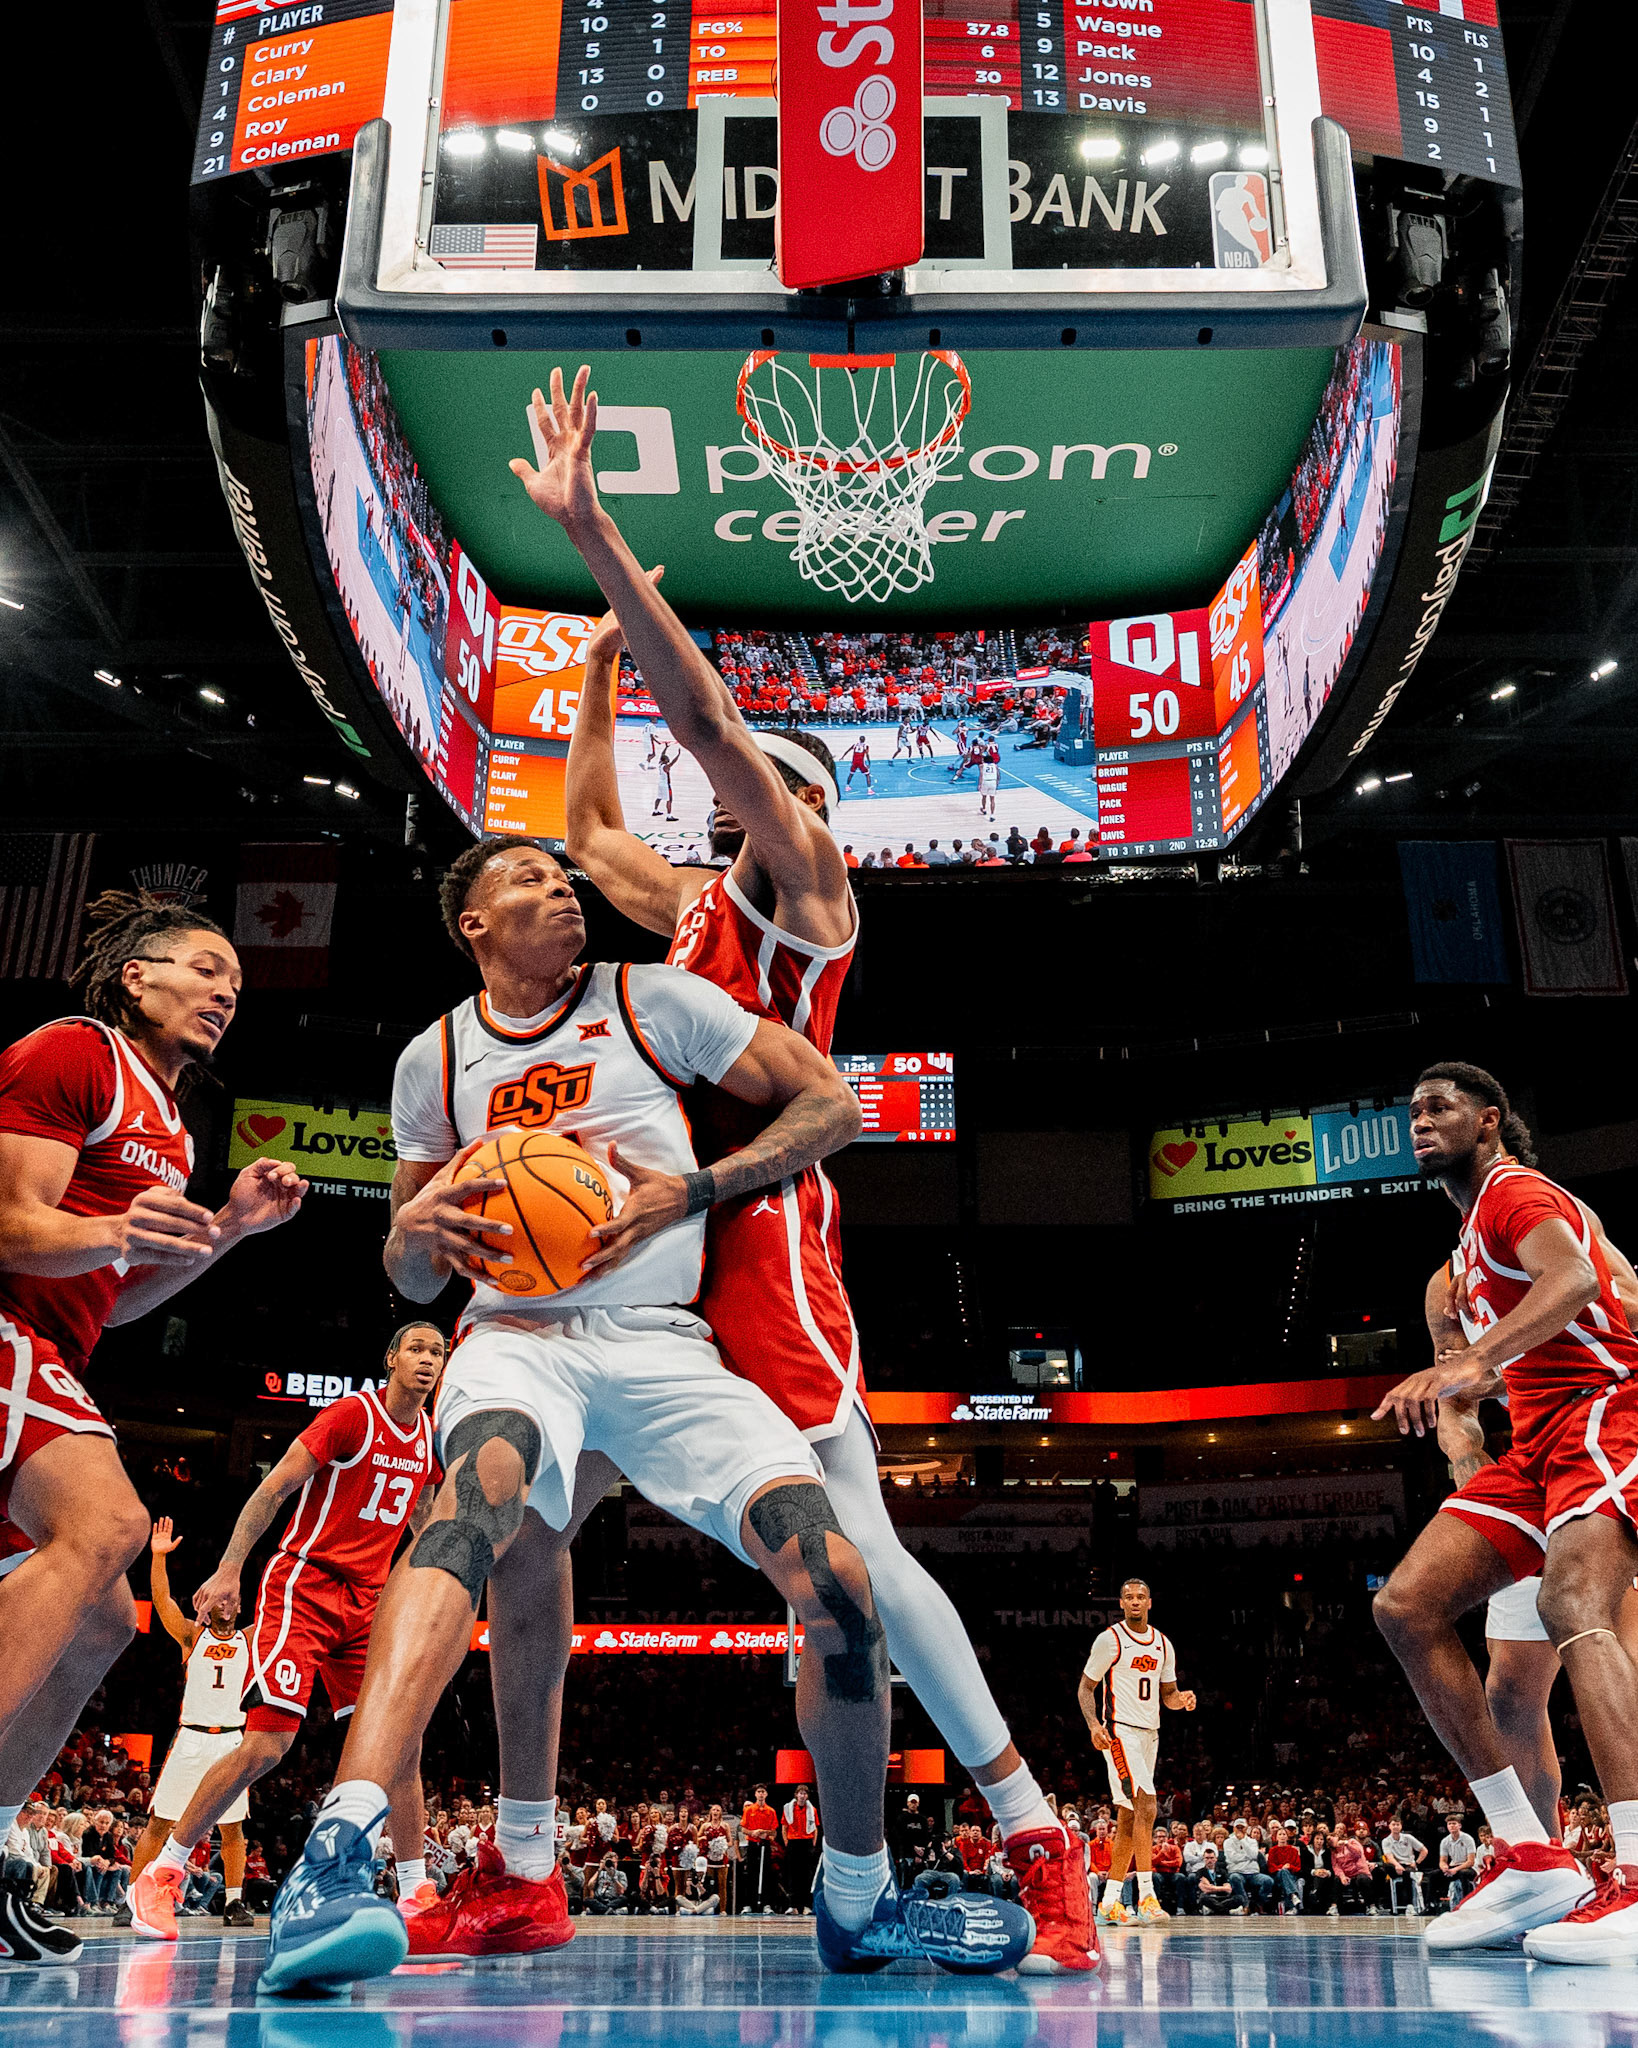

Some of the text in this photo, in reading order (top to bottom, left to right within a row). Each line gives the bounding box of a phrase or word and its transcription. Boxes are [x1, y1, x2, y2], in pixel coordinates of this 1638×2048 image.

[258, 5, 324, 36] PLAYER
[580, 12, 666, 34] 10 2
[698, 20, 743, 35] FG%
[966, 23, 1009, 37] 37.8
[1036, 13, 1163, 38] 5 Wague
[1407, 16, 1489, 49] PTS FLS
[220, 39, 314, 72] 0 Curry
[585, 38, 663, 59] 5 1
[697, 45, 726, 59] TO
[981, 46, 995, 58] 6
[1037, 38, 1137, 61] 9 Pack
[1409, 43, 1484, 73] 10 1
[220, 64, 307, 96] 1 Clary
[579, 64, 665, 86] 13 0
[696, 68, 738, 83] REB
[975, 70, 1002, 84] 30
[1032, 63, 1152, 88] 12 Jones
[1418, 68, 1489, 98] 4 2
[213, 81, 346, 121] 4 Coleman
[581, 90, 663, 111] 0 0
[1033, 89, 1060, 106] 13
[1079, 93, 1147, 114] Davis
[1415, 90, 1490, 123] 15 1
[210, 118, 288, 147] 9 Roy
[1424, 118, 1493, 148] 9 1
[202, 133, 340, 175] 21 Coleman
[1428, 143, 1496, 173] 2 1
[1009, 160, 1170, 236] BANK
[1224, 251, 1251, 268] NBA
[222, 461, 347, 719] paycom center
[496, 612, 598, 677] OS
[1348, 534, 1468, 757] paycom center
[457, 638, 480, 703] 50
[1230, 641, 1251, 702] 45
[529, 688, 580, 735] 45
[1129, 689, 1180, 738] 50
[494, 738, 525, 750] PLAYER
[1099, 741, 1215, 762] PLAYER PTS FL
[492, 754, 520, 766] CURRY
[1098, 757, 1213, 778] BROWN 10 1
[490, 770, 517, 782] CLARY
[1098, 773, 1214, 793] WAGUE 4 2
[490, 786, 528, 799] COLEMAN
[1099, 789, 1215, 809] PACK 15 1
[488, 801, 506, 812] ROY
[1100, 805, 1217, 825] JONES 9 1
[487, 818, 526, 831] COLEMAN
[1101, 821, 1218, 841] DAVIS 2 1
[1107, 838, 1219, 857] TO 3 TF 3 2ND 12:26
[129, 862, 209, 893] THUNDER
[843, 1062, 876, 1072] 12:26
[894, 1057, 922, 1073] 50
[487, 1061, 597, 1132] OSU
[1321, 1115, 1401, 1174] LOUD
[120, 1140, 189, 1197] OKLAHOM
[312, 1182, 347, 1196] THE
[1173, 1199, 1226, 1214] BRING
[1231, 1196, 1264, 1209] THE
[1269, 1187, 1353, 1204] THUNDER
[1381, 1180, 1421, 1194] EXIT
[265, 1372, 388, 1397] OU BEDLA
[970, 1395, 1034, 1404] PRESENTED BY
[372, 1453, 424, 1473] OKLAHOMA
[358, 1472, 414, 1526] 13
[203, 1643, 238, 1660] OSU
[1130, 1655, 1158, 1672] OSU
[212, 1665, 225, 1689] 1
[275, 1659, 301, 1696] OU
[1138, 1677, 1151, 1700] 0
